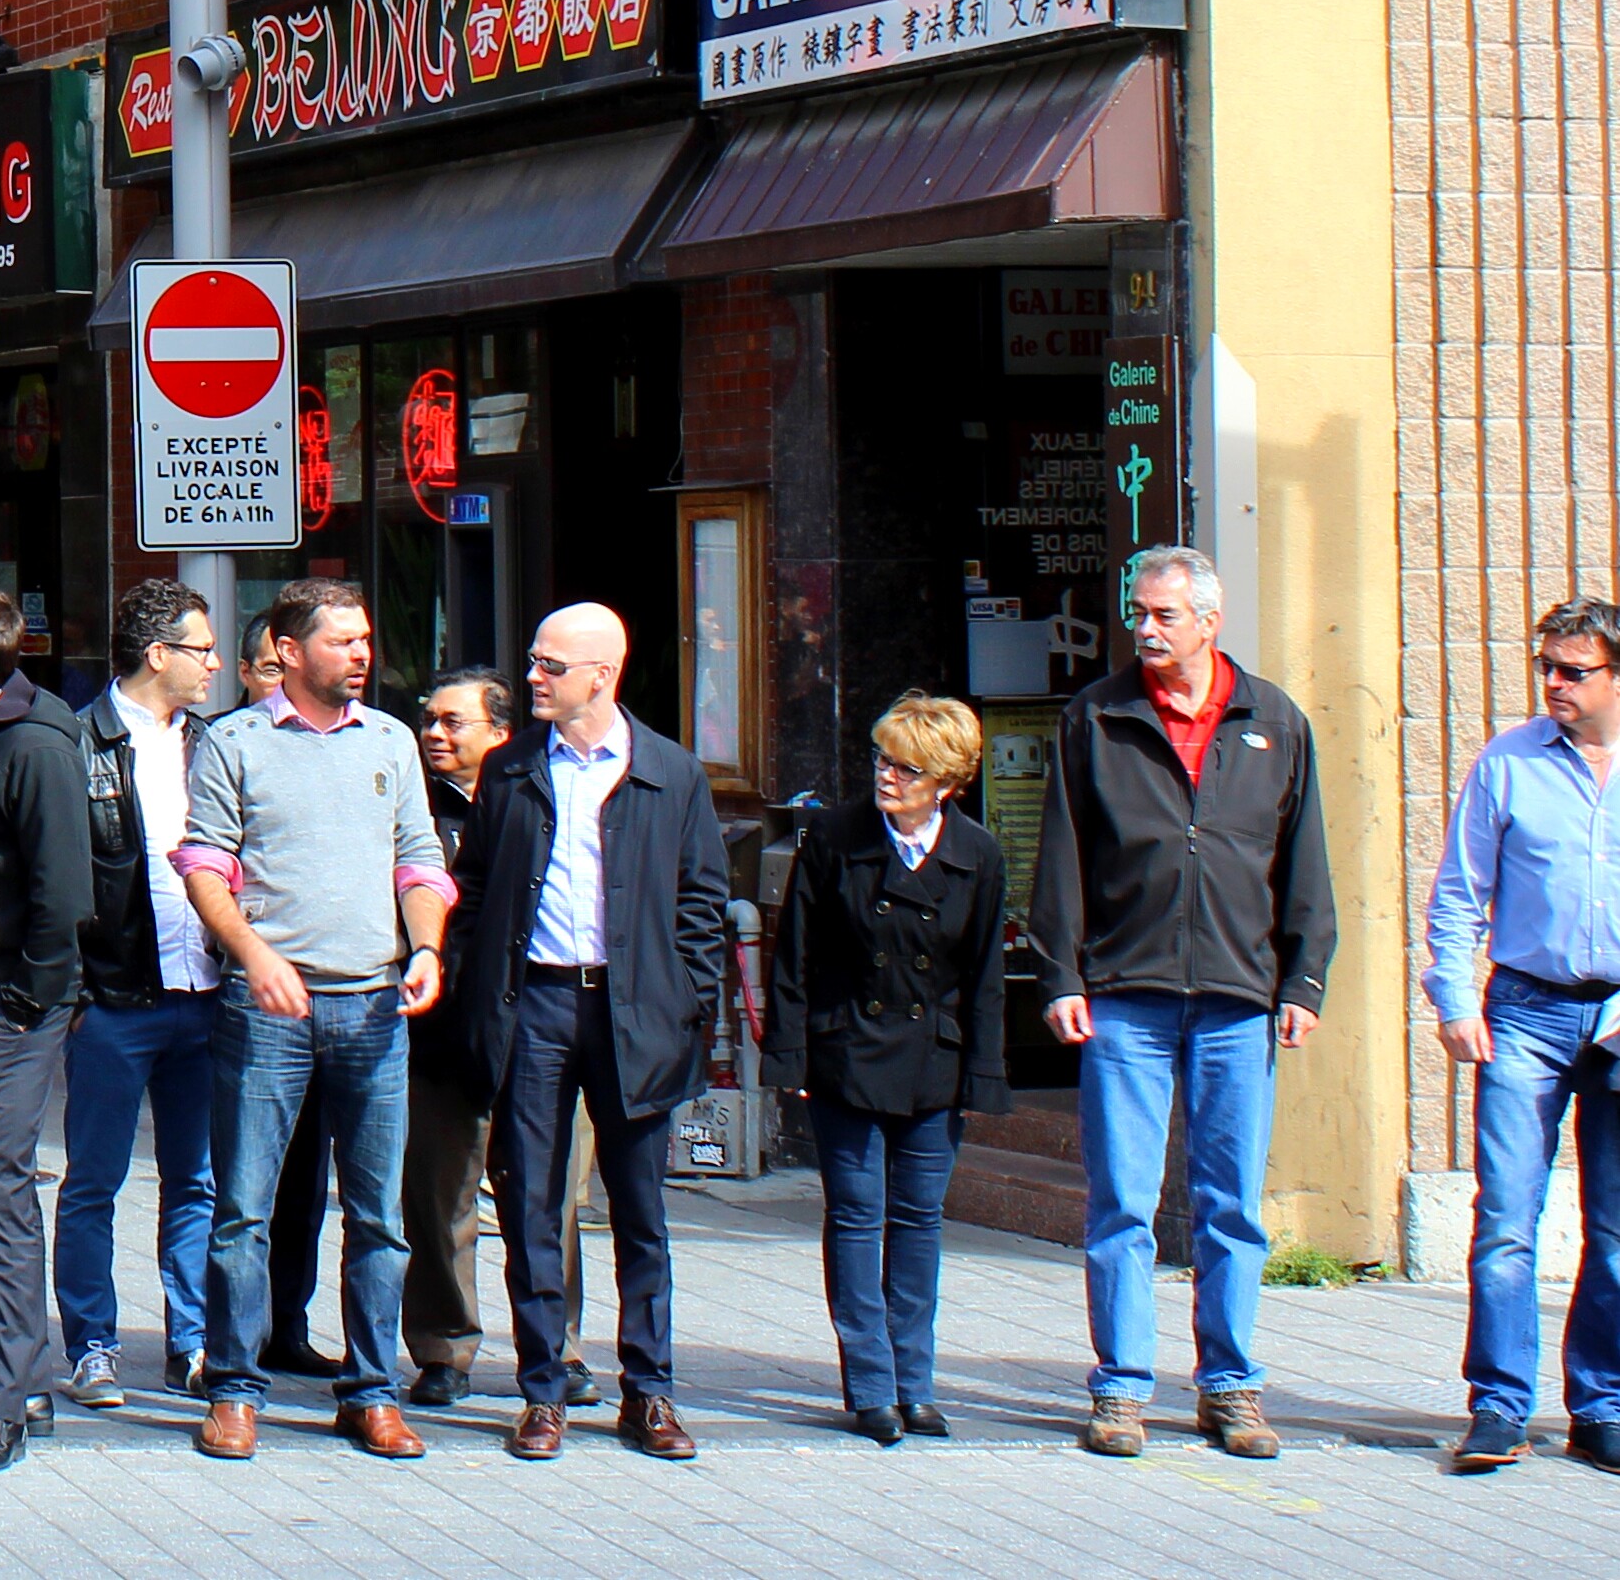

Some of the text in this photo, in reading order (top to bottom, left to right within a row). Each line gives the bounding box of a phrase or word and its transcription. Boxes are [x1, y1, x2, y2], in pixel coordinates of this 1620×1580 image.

[1011, 335, 1038, 357] de
[1109, 361, 1157, 388] Galerie
[1108, 399, 1160, 426] de Chine
[167, 431, 268, 455] EXCEPTÉ
[157, 459, 279, 478] LIVRAISON
[174, 483, 263, 501] LOCALE
[165, 507, 193, 524] DE
[201, 506, 227, 523] 6h
[247, 506, 274, 522] 11h
[972, 602, 993, 612] VISA
